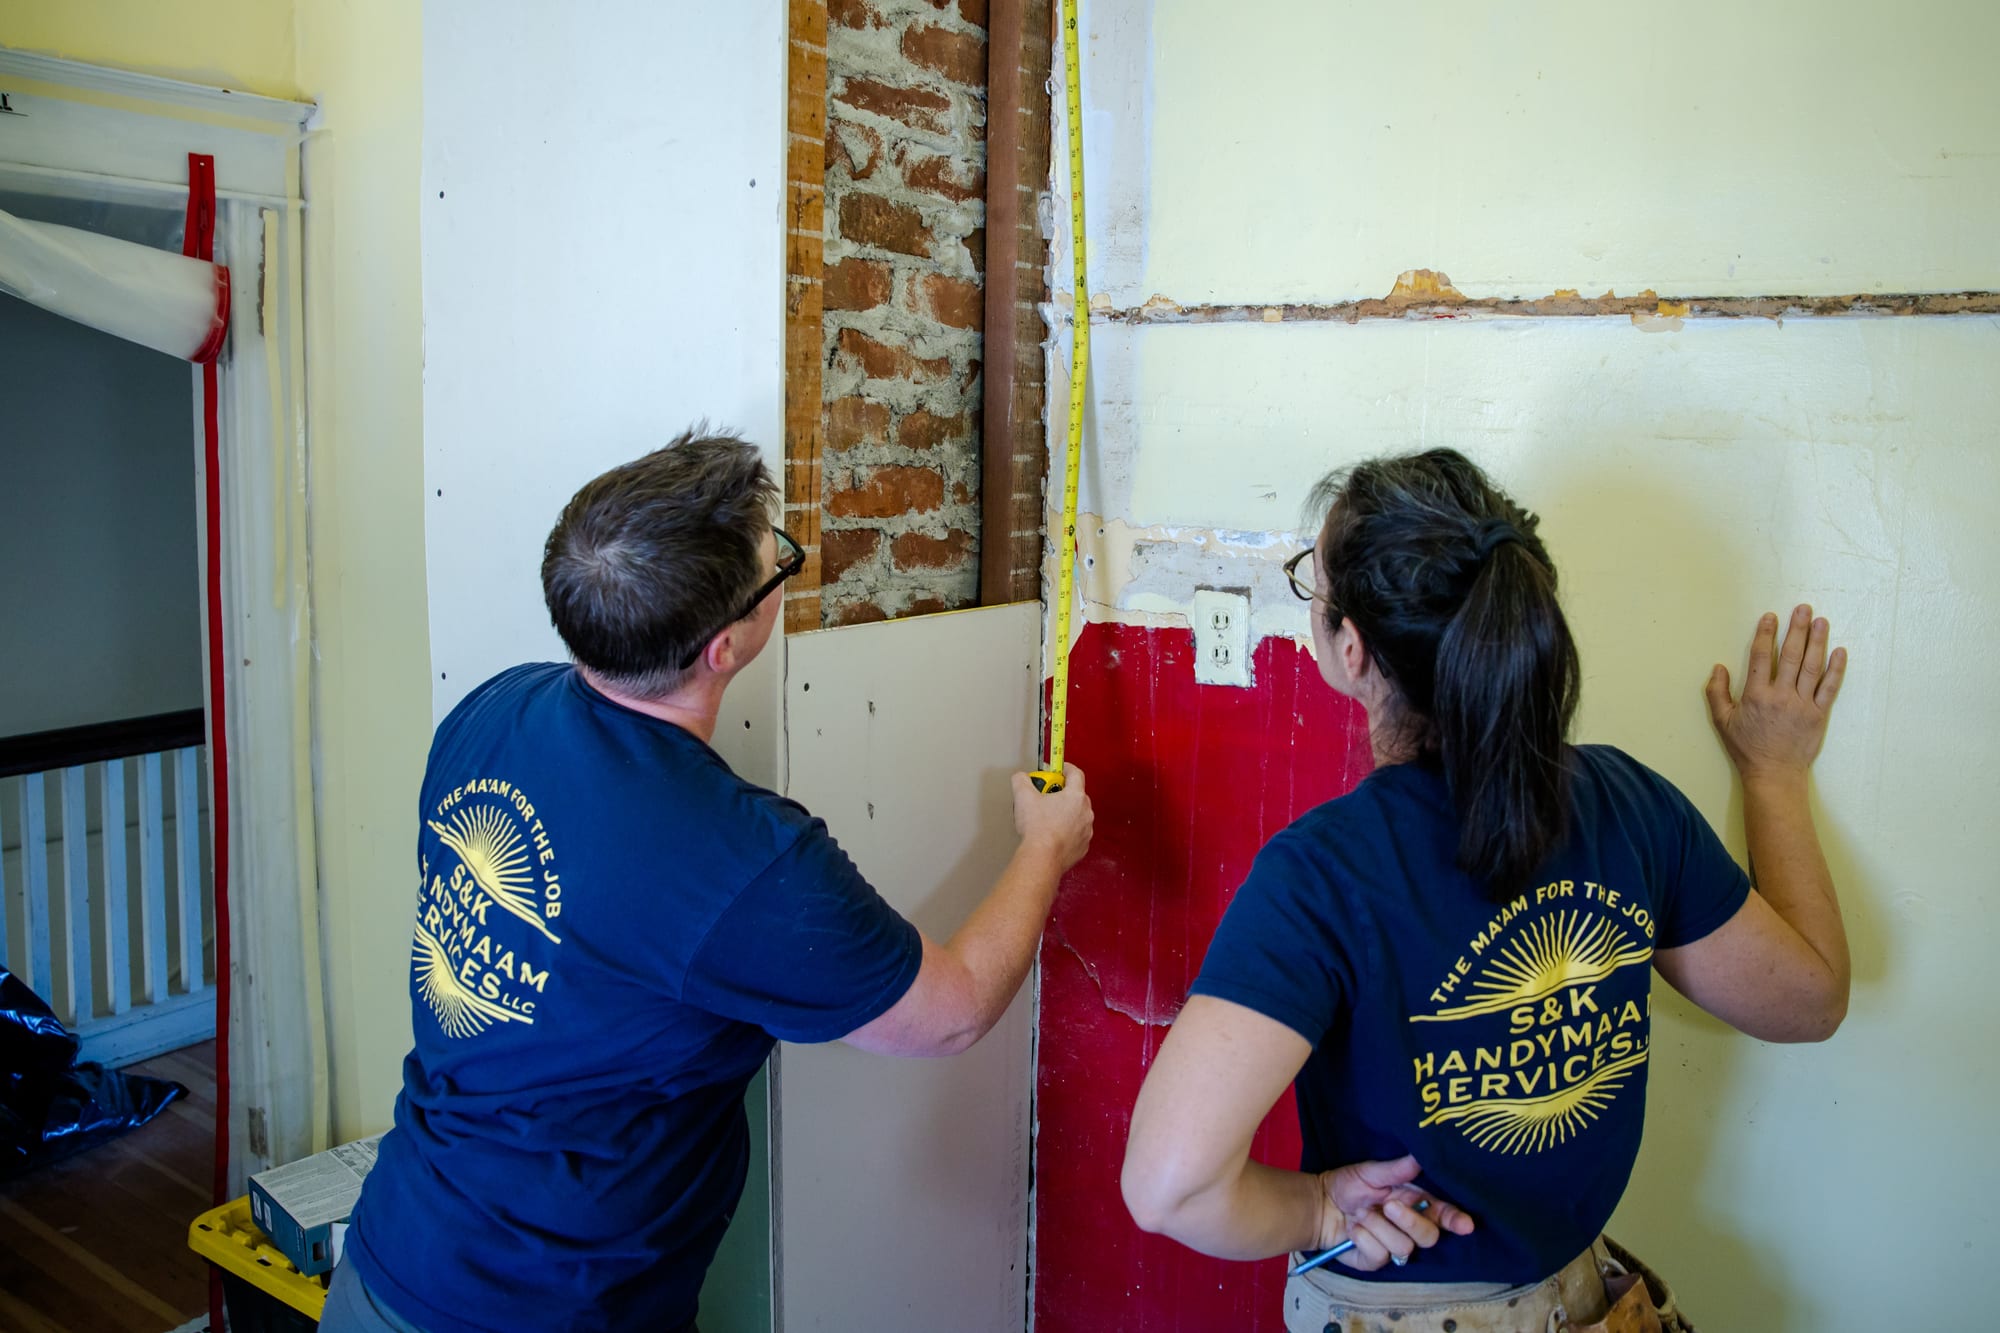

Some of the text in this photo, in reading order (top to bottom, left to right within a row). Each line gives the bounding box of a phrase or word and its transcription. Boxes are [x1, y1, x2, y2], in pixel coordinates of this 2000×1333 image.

[437, 779, 562, 918] THE MA'AM FOR THE JOB
[449, 863, 493, 926] S&K
[1430, 879, 1656, 1005] THE MA'AM FOR THE JOB
[502, 992, 536, 1014] LLC
[1413, 992, 1652, 1085] HANDYMA'A
[1510, 985, 1600, 1035] S&K
[1421, 1031, 1633, 1113] SERVICES
